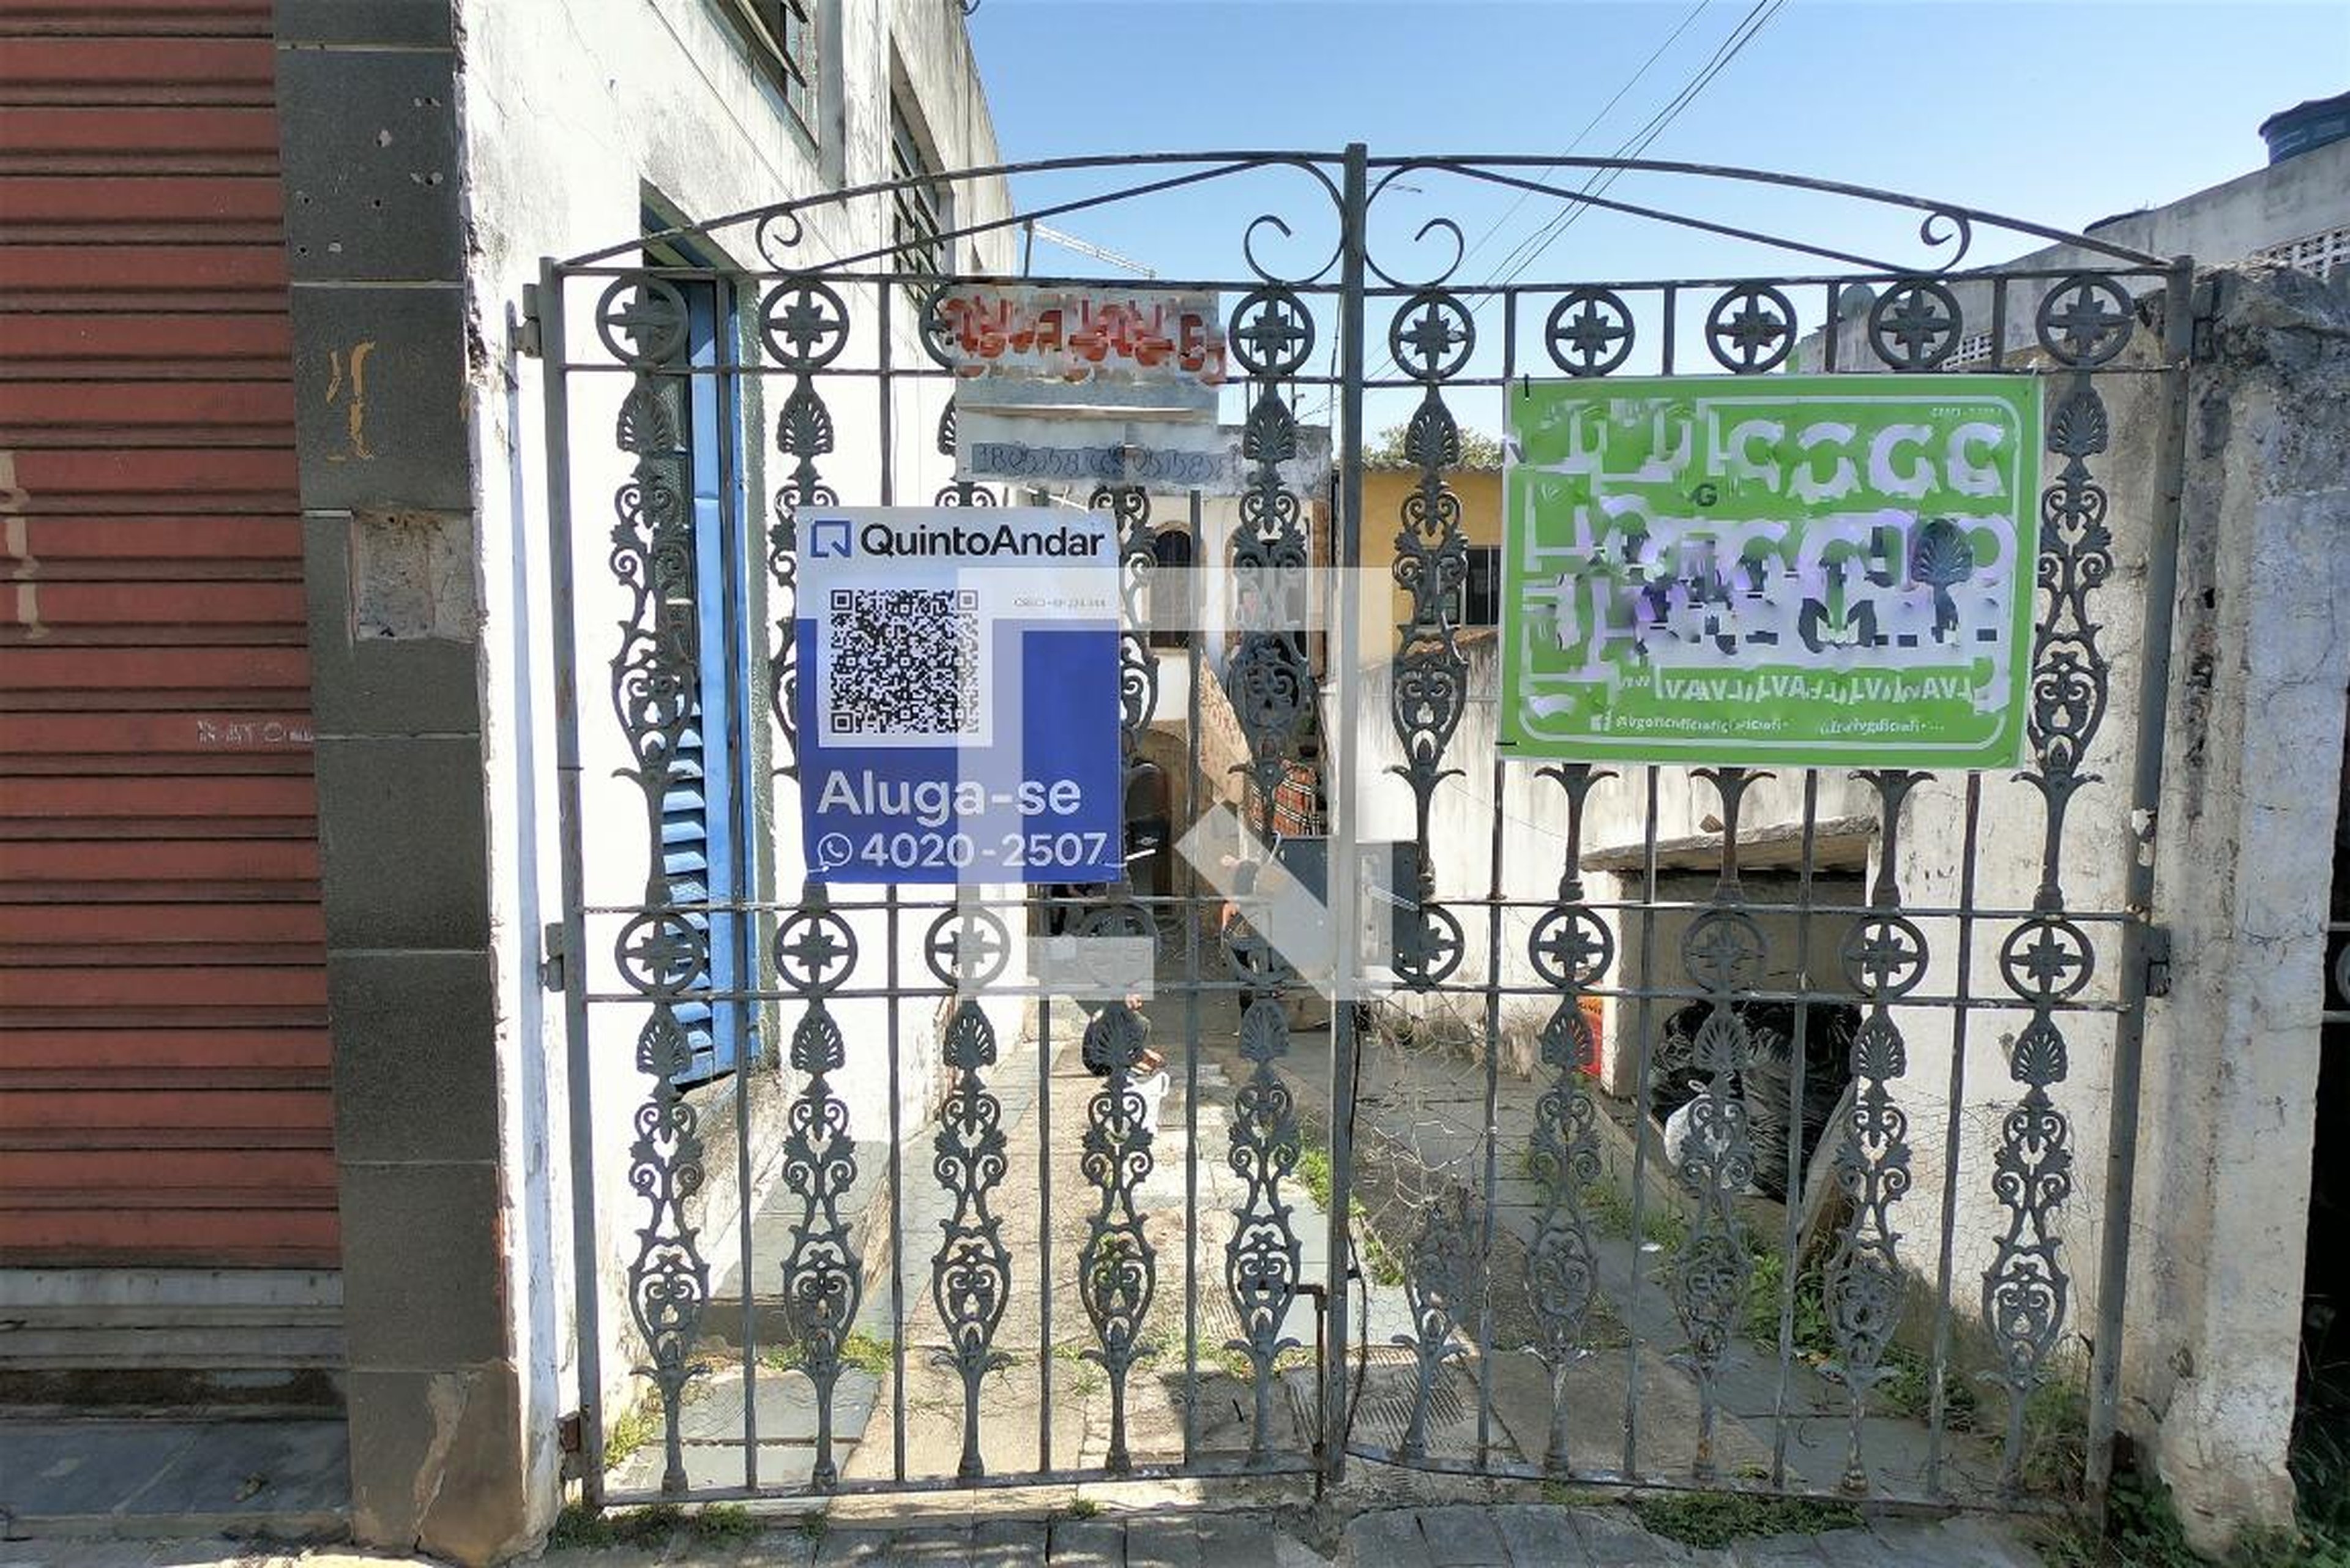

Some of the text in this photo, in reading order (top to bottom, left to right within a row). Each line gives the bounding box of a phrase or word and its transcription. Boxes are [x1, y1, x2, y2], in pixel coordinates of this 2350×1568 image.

[861, 523, 1105, 558] QuintoAndar
[816, 769, 1081, 827] Aluga-se
[860, 832, 1108, 868] 4020-2507
